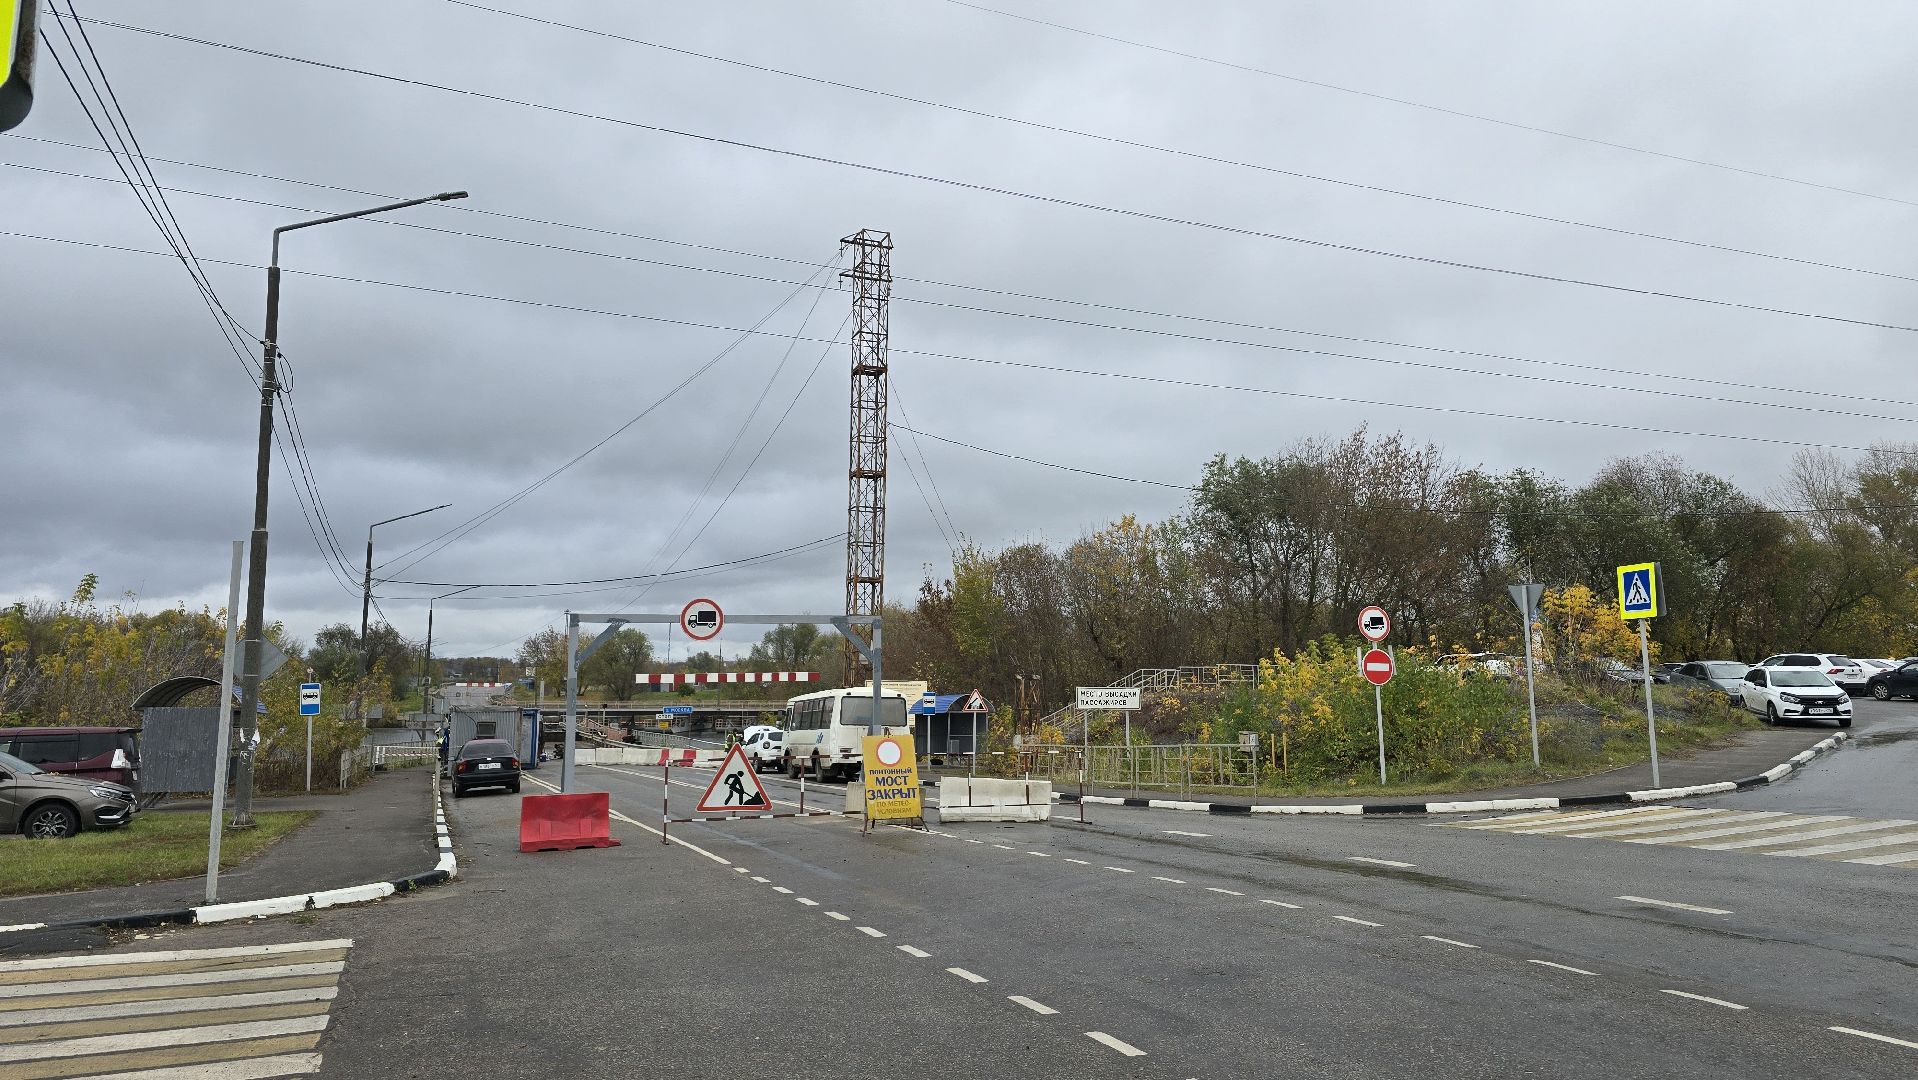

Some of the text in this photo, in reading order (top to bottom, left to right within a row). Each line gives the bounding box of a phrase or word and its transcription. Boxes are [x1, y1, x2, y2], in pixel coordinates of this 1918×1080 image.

[869, 767, 912, 775] ПОНТОННЫЙ
[876, 776, 909, 786] МОСТ
[867, 788, 917, 800] ЗАКРЫТ
